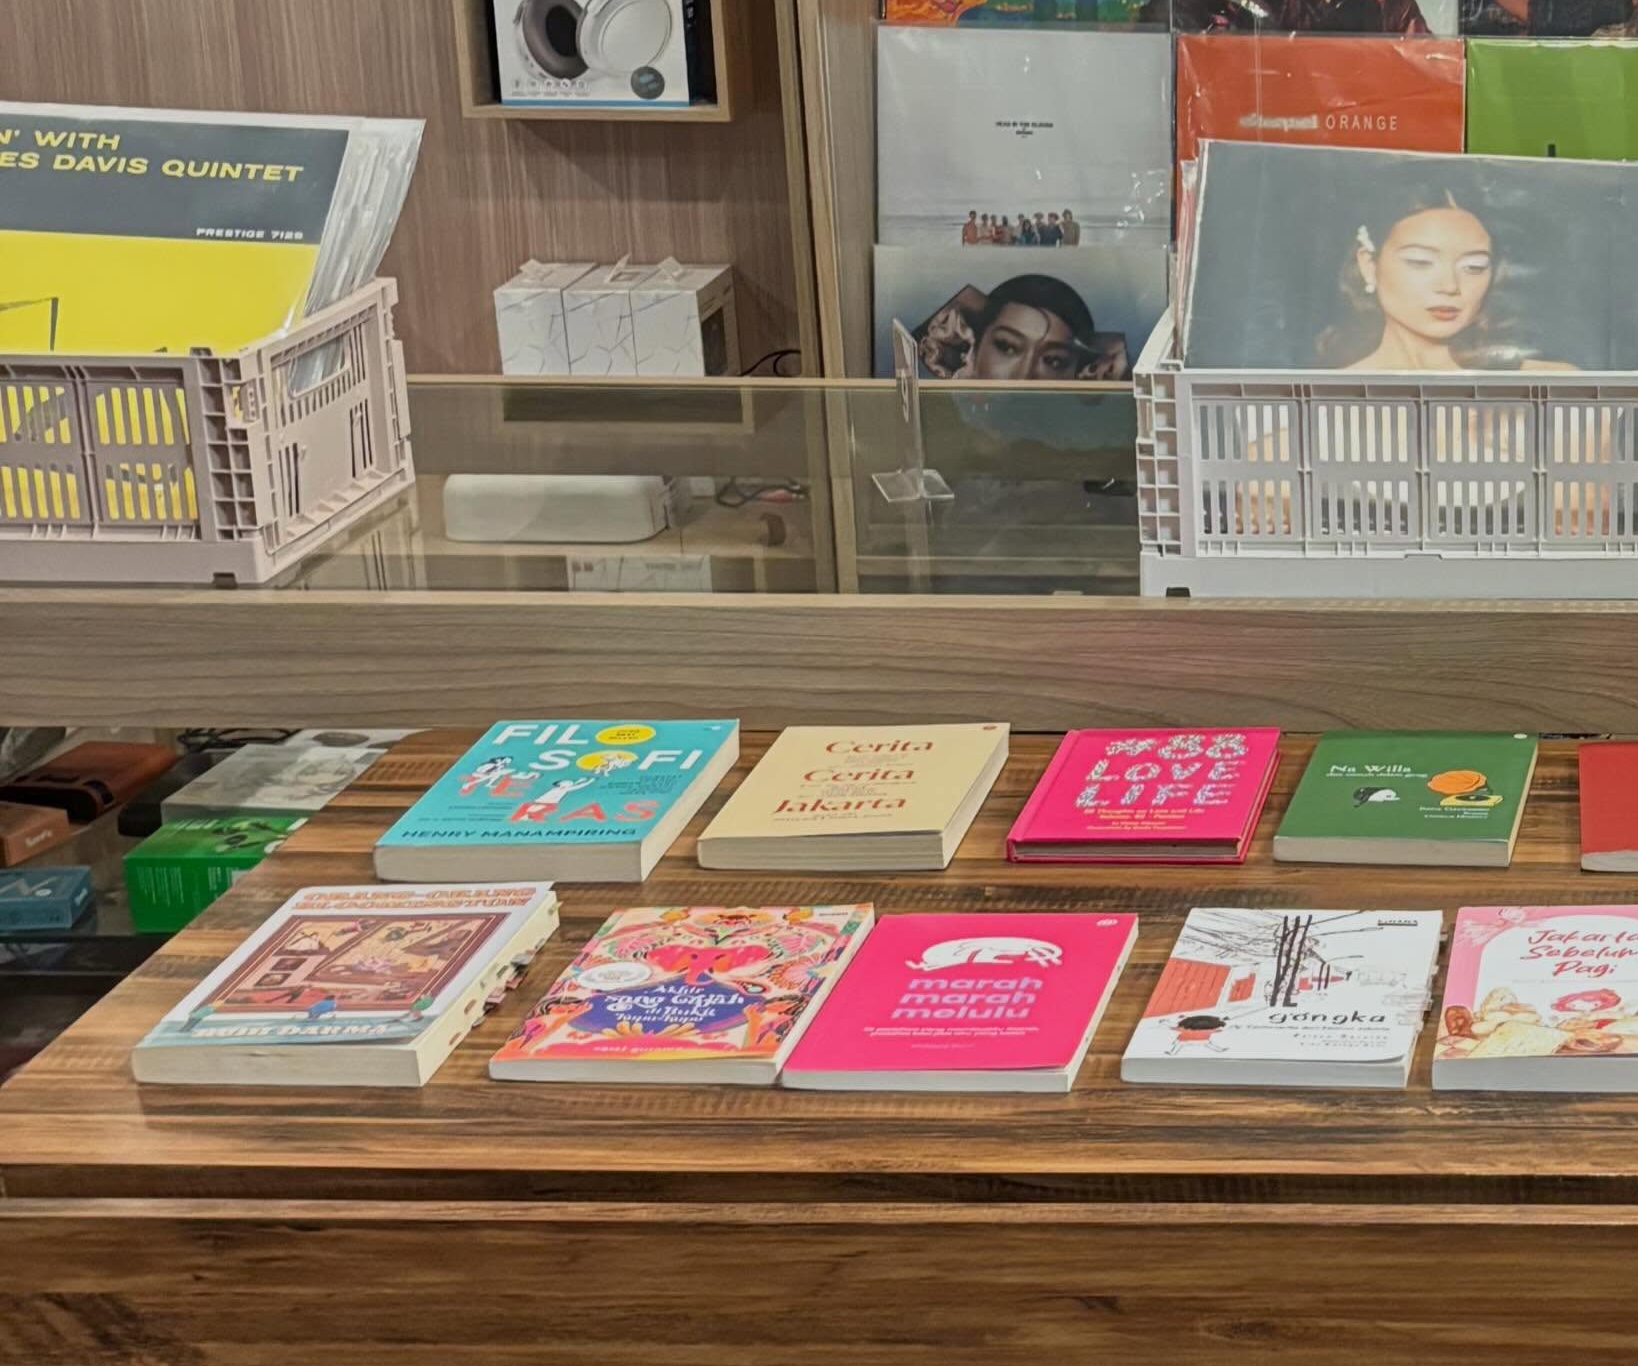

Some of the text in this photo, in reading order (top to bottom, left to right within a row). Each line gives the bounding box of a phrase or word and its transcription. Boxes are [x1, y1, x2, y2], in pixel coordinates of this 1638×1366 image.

[1325, 114, 1398, 131] ORANGE
[34, 130, 121, 150] WITH
[53, 154, 148, 175] DAVIS
[161, 161, 304, 183] QUINTET
[196, 227, 266, 239] PRESTIGE
[825, 739, 934, 754] Cerita
[803, 768, 915, 782] Cerita
[1085, 758, 1246, 782] LOVE
[1330, 764, 1412, 773] Na Willa
[1075, 783, 1235, 808] LIFE
[508, 800, 662, 823] RAS
[772, 798, 906, 814] Jakarta
[401, 827, 637, 839] HENRY MANAMPIRING
[1552, 960, 1618, 978] Pagi
[908, 977, 1043, 991] marah
[900, 991, 1036, 1005] marah
[891, 1005, 1031, 1020] melulu
